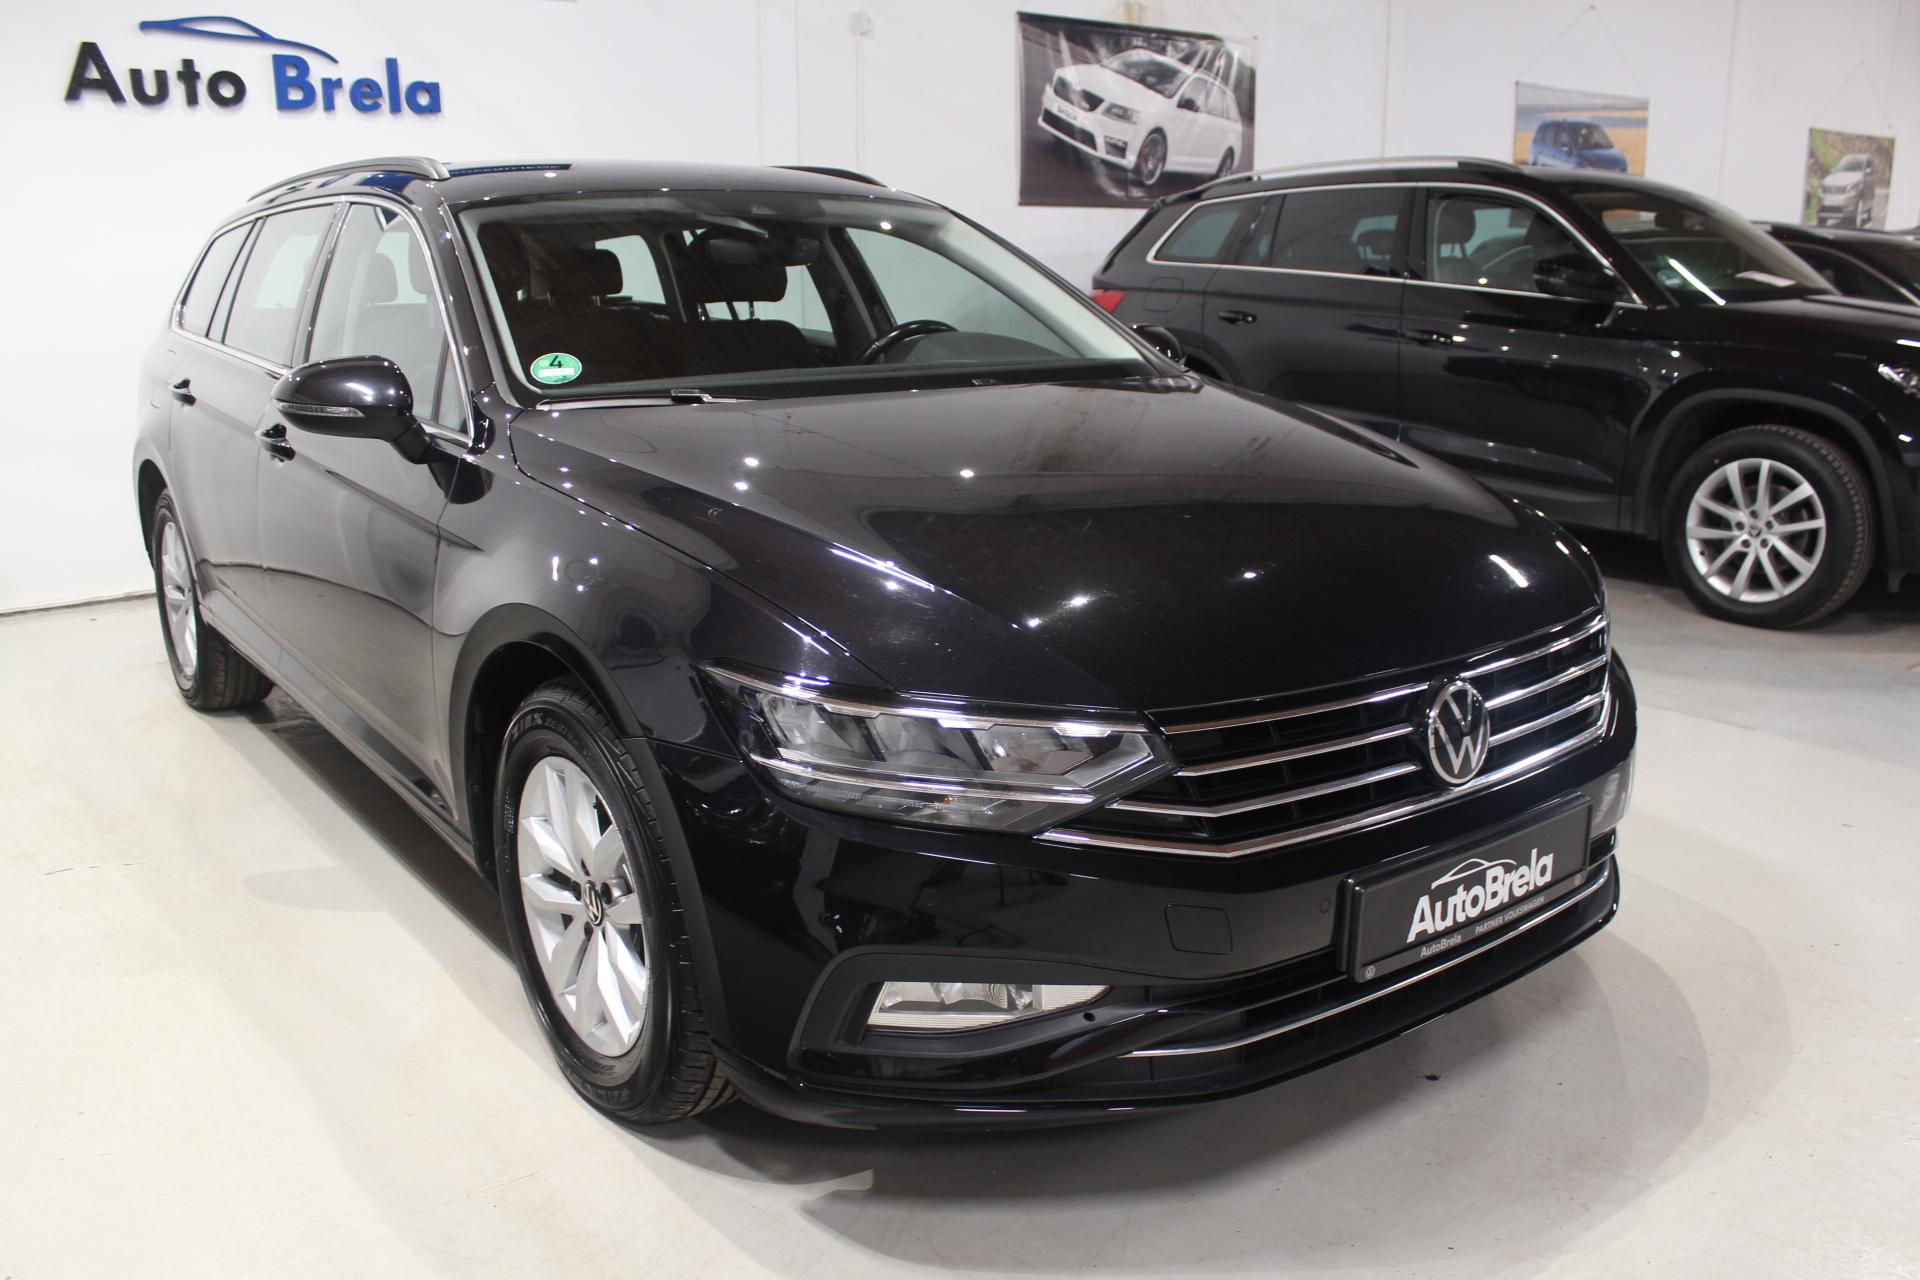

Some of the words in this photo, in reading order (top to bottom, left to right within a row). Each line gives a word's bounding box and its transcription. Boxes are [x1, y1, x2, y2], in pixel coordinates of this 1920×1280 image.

[64, 42, 247, 108] Auto
[272, 54, 442, 115] Brela
[549, 355, 563, 368] 4
[1407, 848, 1554, 943] AutoBrela
[1420, 935, 1462, 958] AutoBrela
[1475, 916, 1504, 935] PARTNER
[1504, 896, 1546, 921] VOLKSWAGEN
